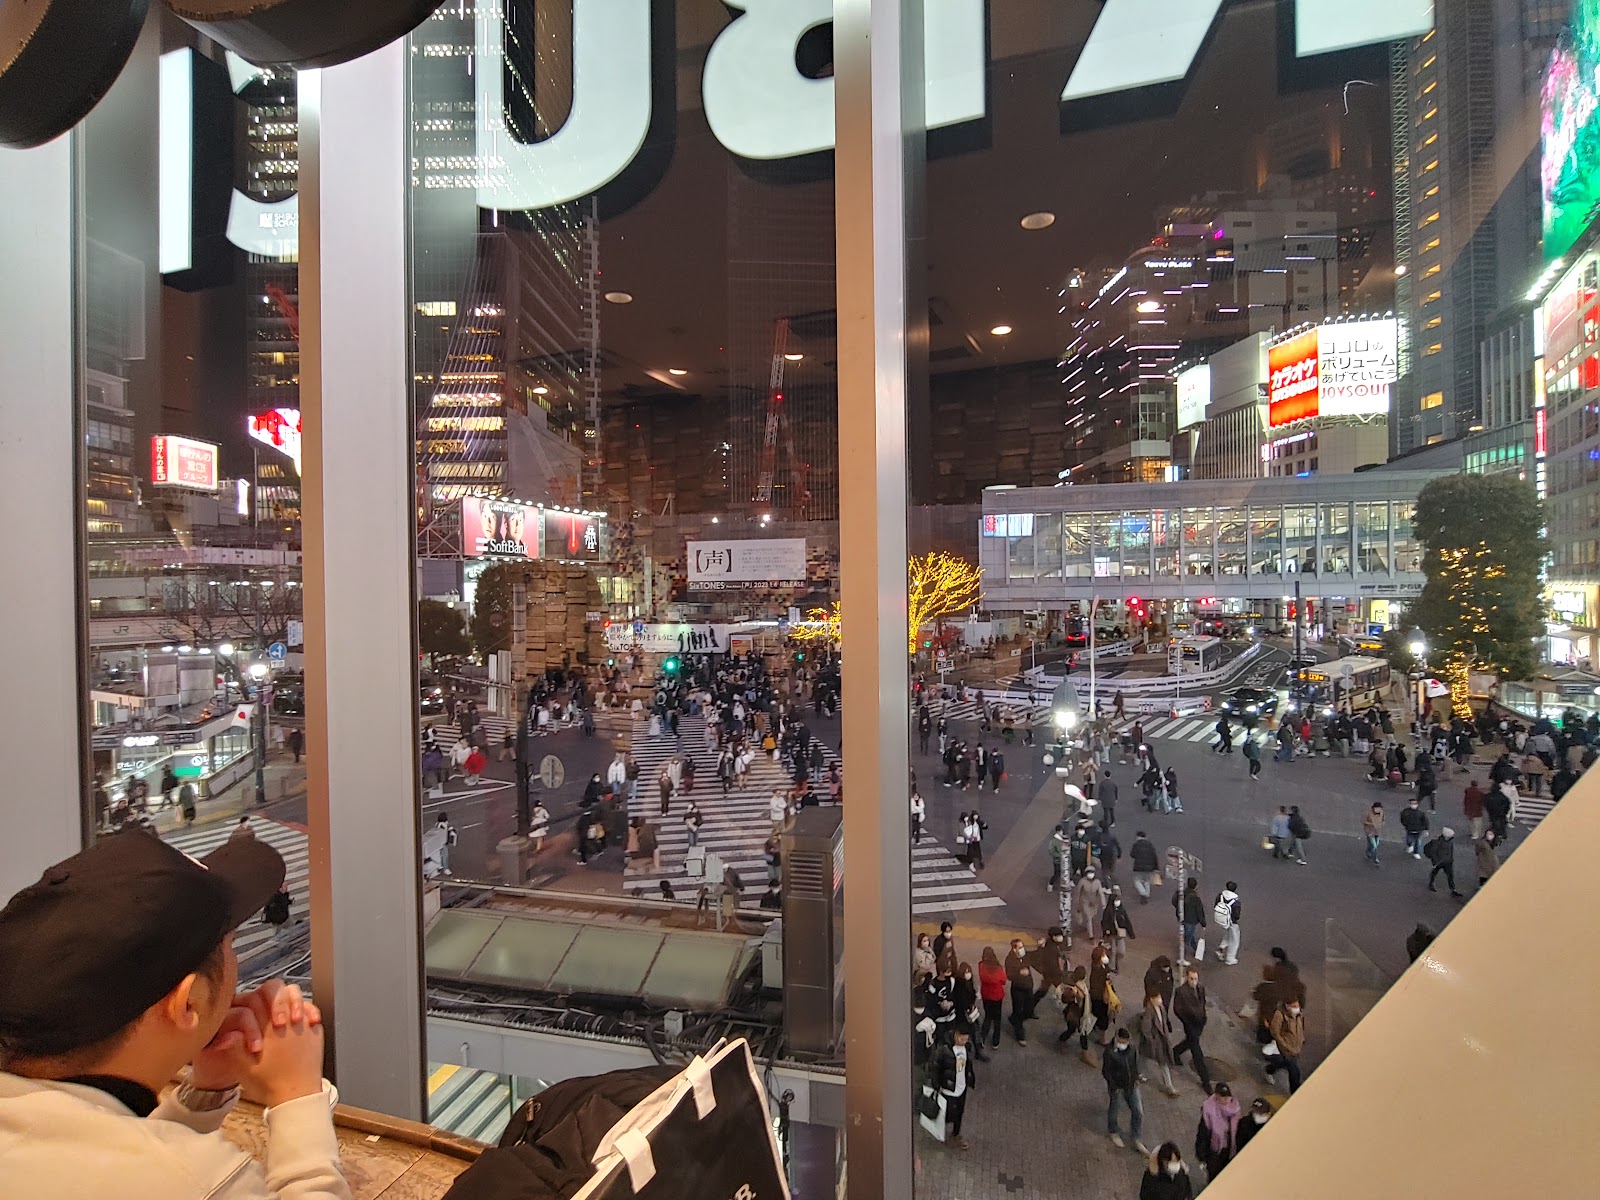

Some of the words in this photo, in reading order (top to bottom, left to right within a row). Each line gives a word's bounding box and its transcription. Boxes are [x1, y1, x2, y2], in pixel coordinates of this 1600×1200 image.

[1322, 340, 1384, 355] ココロの
[1322, 354, 1395, 370] ボリューム
[1271, 358, 1317, 390] カラオケ
[1322, 370, 1397, 384] あげていこう
[490, 539, 528, 554] SoftBank
[689, 581, 725, 590] SixTONES
[113, 625, 130, 634] JR
